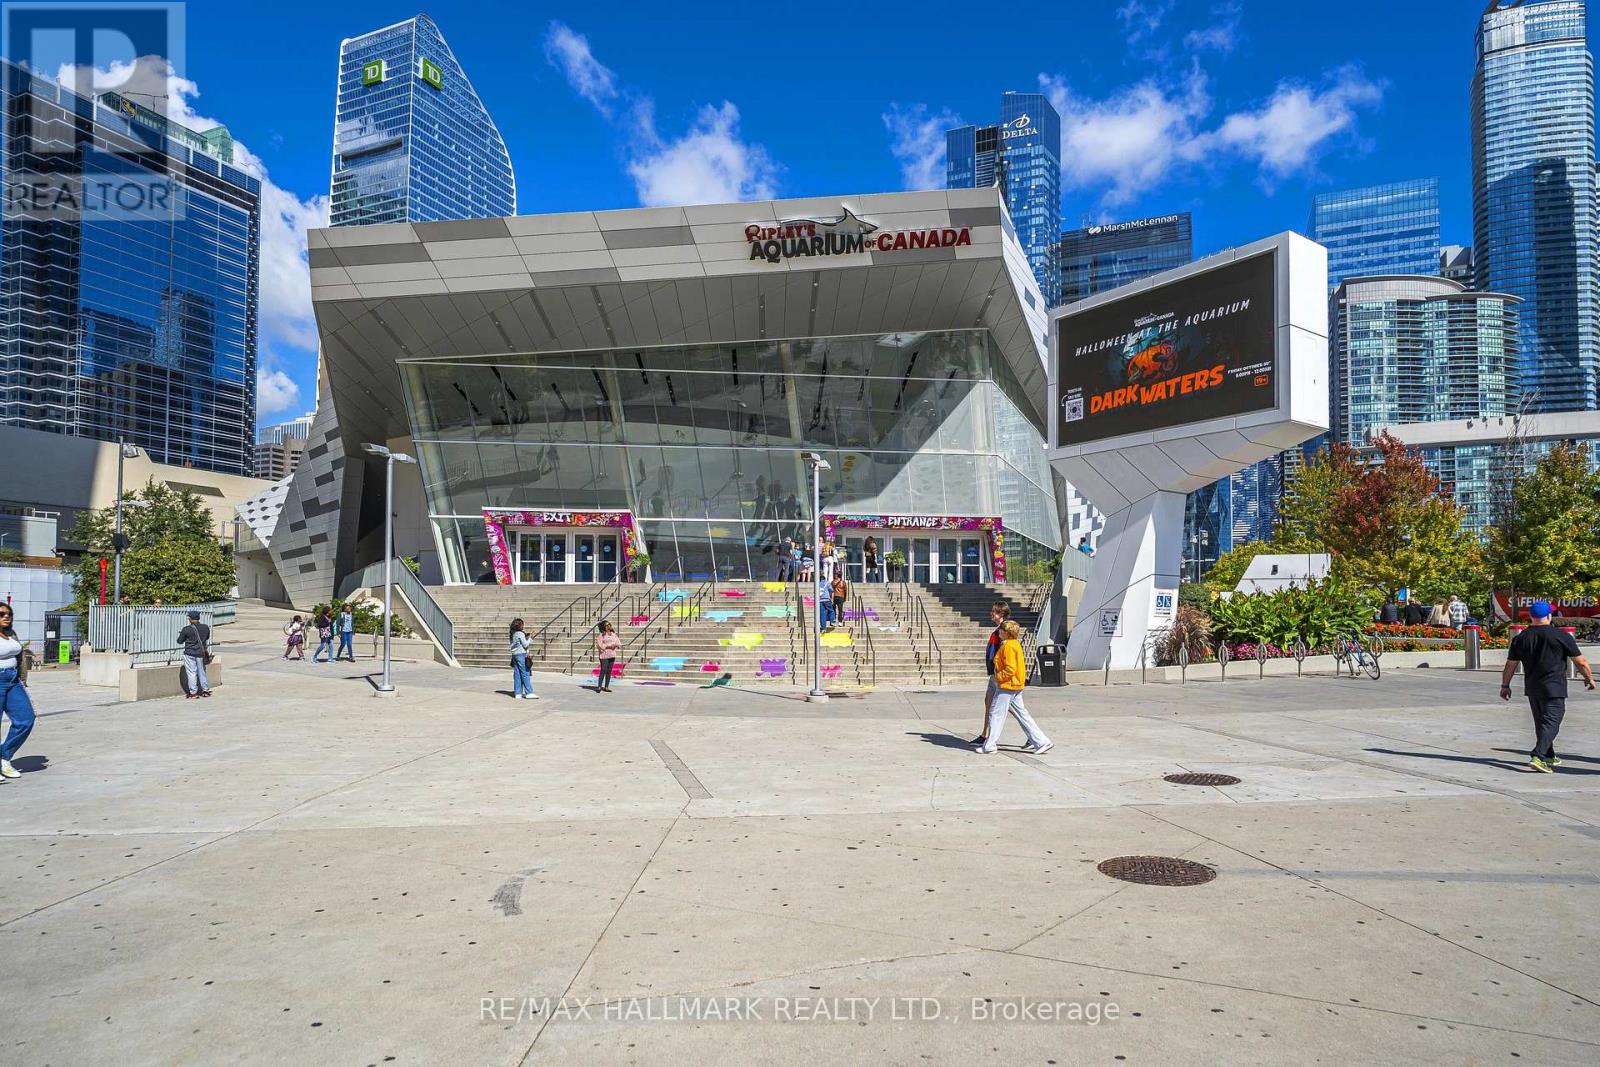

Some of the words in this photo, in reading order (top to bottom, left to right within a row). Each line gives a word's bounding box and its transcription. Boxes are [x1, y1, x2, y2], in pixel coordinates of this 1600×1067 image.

[364, 64, 379, 80] TD
[425, 62, 441, 84] TD
[1002, 127, 1038, 140] DELTA
[745, 224, 816, 244] RIPLEY'S
[749, 233, 865, 264] AQUARIUM
[864, 240, 878, 248] OF
[877, 228, 972, 251] CANADA
[1075, 332, 1134, 357] HALLOWEEN
[1139, 327, 1152, 339] AT
[1158, 319, 1179, 334] THE
[1184, 298, 1250, 327] AQUARIUM
[1090, 383, 1139, 414] DARK
[1139, 364, 1225, 405] WATERS
[543, 512, 571, 523] EXIT
[887, 516, 938, 527] ENTRANCE
